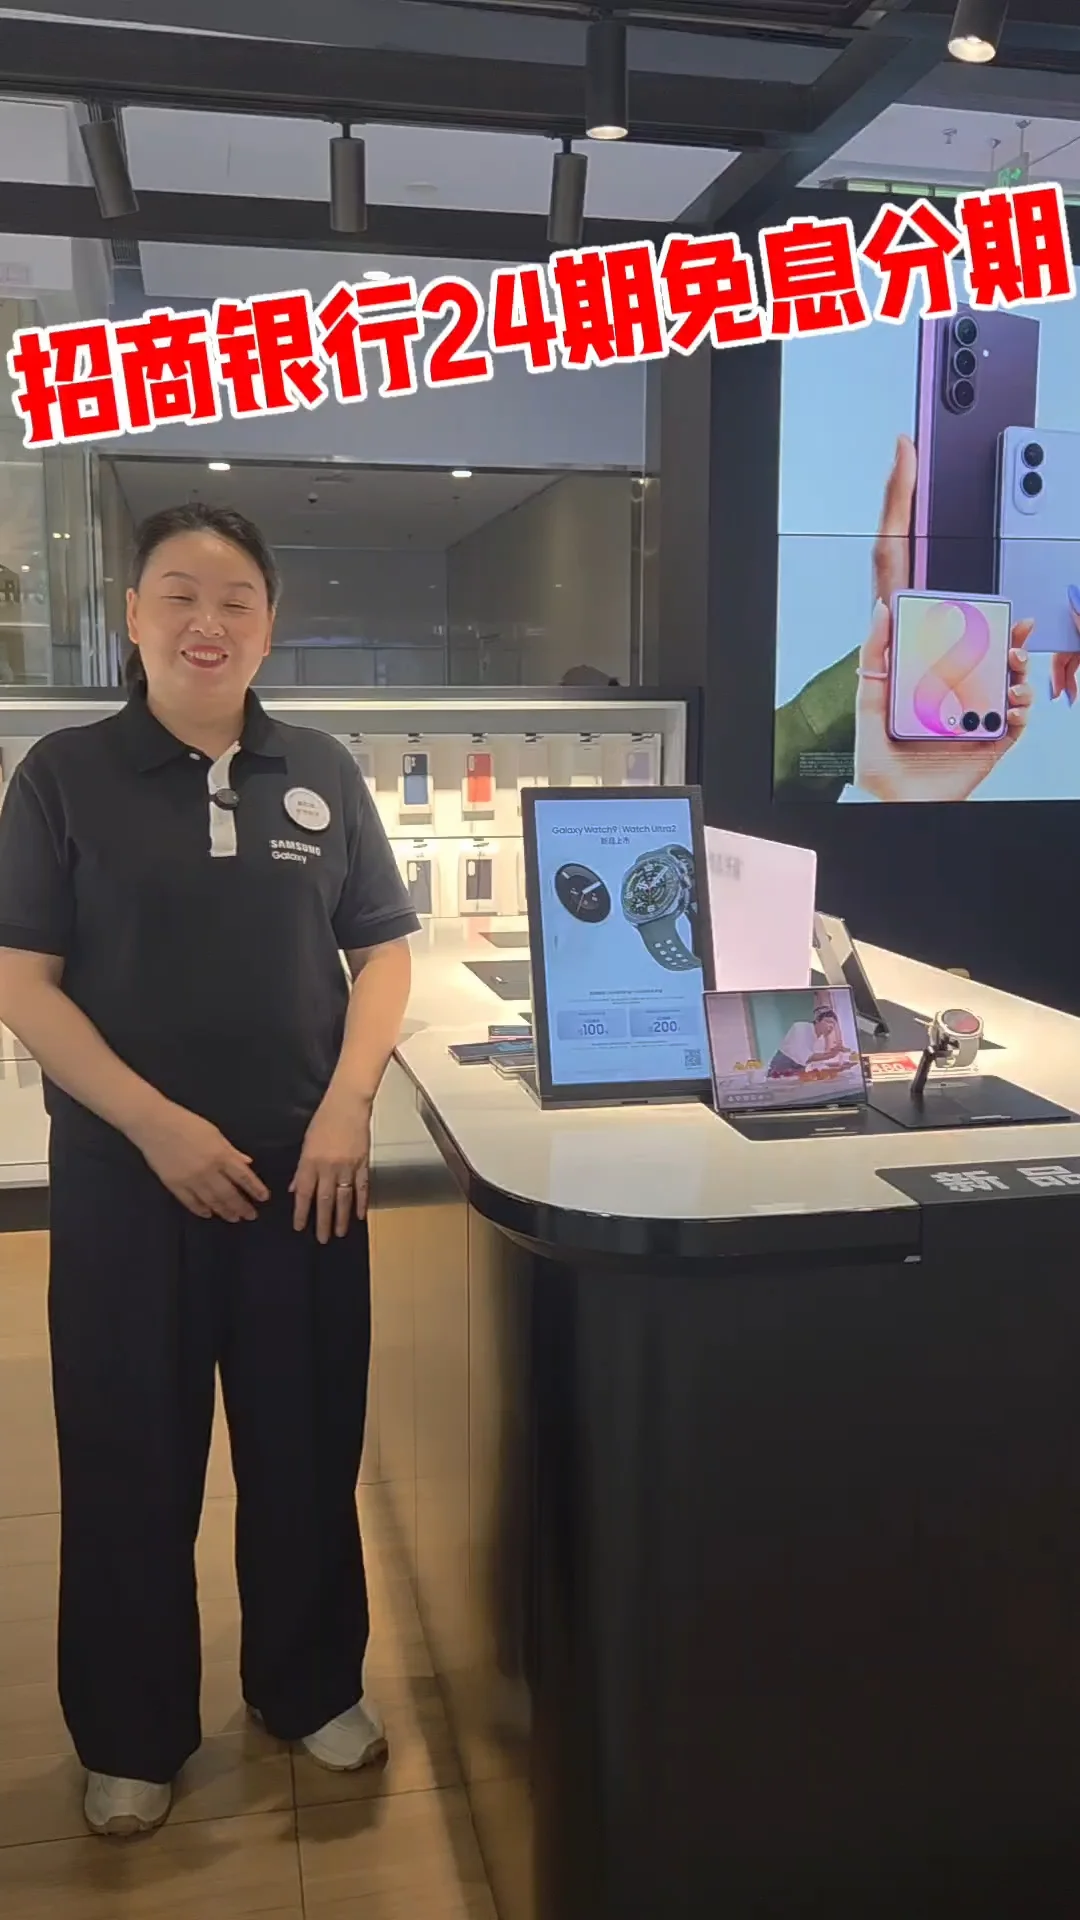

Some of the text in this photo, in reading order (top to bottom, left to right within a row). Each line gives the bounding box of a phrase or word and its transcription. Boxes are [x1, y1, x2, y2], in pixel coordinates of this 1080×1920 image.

[551, 824, 677, 836] Galaxy Watch9 Watch Ultra2
[269, 839, 321, 857] SAMSUNG
[271, 850, 308, 865] Galaxy
[581, 1023, 605, 1036] 100
[653, 1020, 678, 1033] 200
[930, 1165, 1080, 1193] 新品
